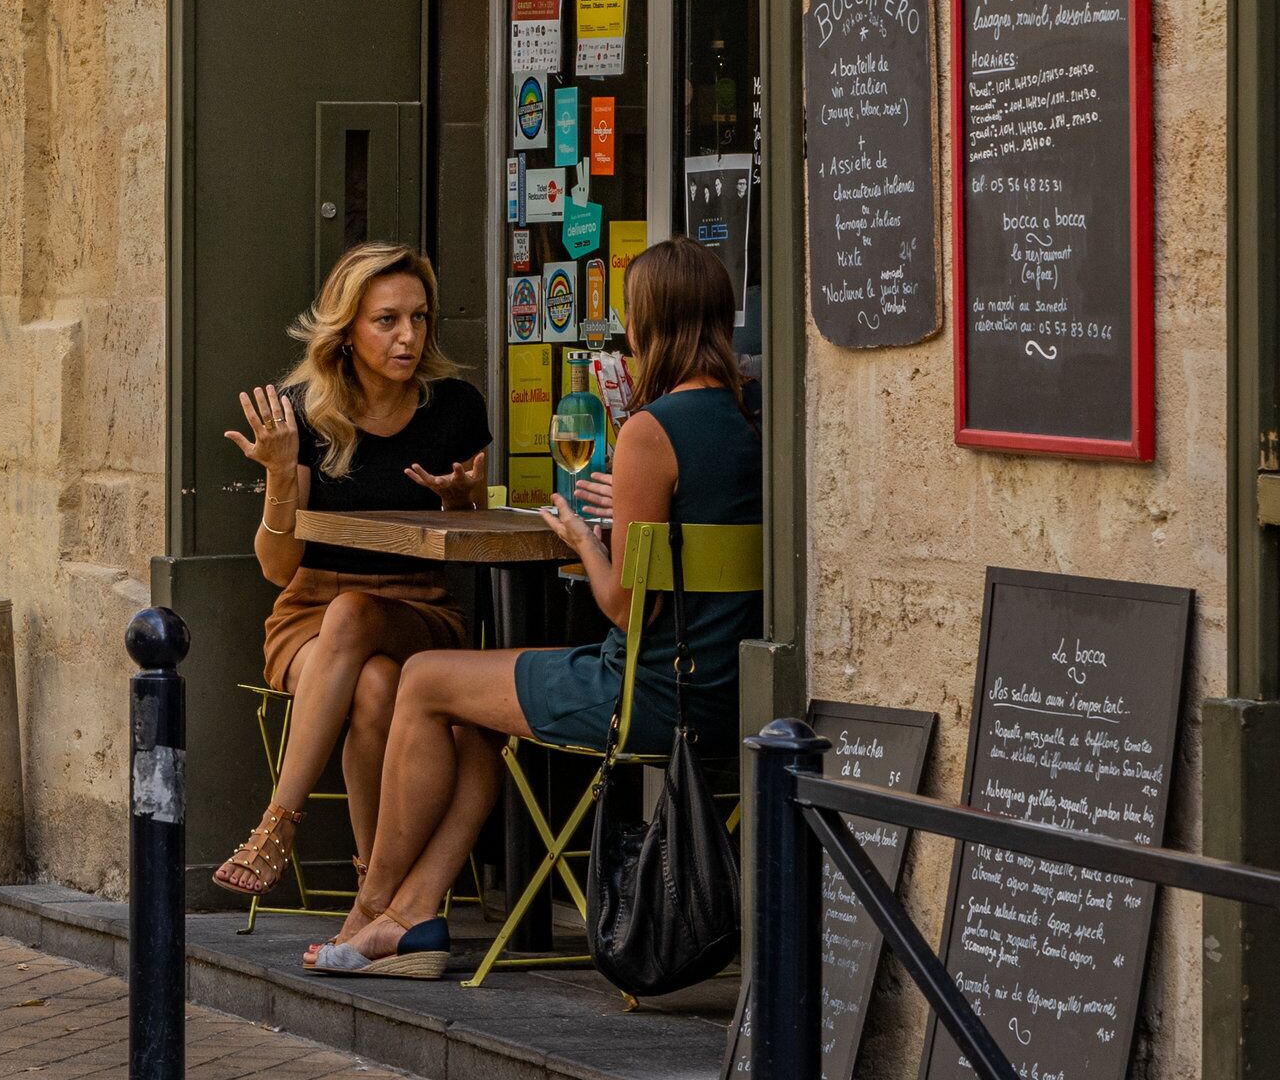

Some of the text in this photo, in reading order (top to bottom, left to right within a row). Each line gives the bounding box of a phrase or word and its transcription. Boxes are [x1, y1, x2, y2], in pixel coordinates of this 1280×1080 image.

[1055, 2, 1091, 26] desserts
[840, 52, 889, 77] bouteille de
[831, 77, 888, 99] vin italien
[830, 150, 888, 175] Assiette de
[536, 184, 547, 192] Ticket
[833, 182, 881, 201] charcuteries
[990, 178, 1063, 193] 05 56 48 25 31
[862, 205, 870, 215] ou
[1003, 213, 1039, 231] bocca
[1055, 207, 1087, 230] bocca
[567, 222, 597, 237] deliveroo
[835, 209, 901, 240] fromages italiens
[863, 236, 872, 246] ou
[1011, 243, 1021, 261] le
[837, 247, 862, 266] Mixte
[866, 278, 875, 298] le
[880, 280, 899, 305] jeudi
[973, 295, 1068, 312] du mardi au samedi
[975, 314, 1112, 340] réservation 05 57 83 69 66
[1052, 637, 1107, 667] La bocca
[990, 676, 1068, 708] Nos salades aussi
[836, 730, 884, 760] Sandwiches
[1070, 734, 1153, 754] de tomates
[841, 760, 901, 787] de la 5€
[1084, 760, 1093, 773] de
[1095, 760, 1120, 781] jambon
[1123, 759, 1135, 777] San
[985, 778, 1025, 808] Aubergines
[1092, 802, 1121, 825] jambon
[1123, 804, 1141, 823] blanc
[977, 844, 1014, 864] Mix de la
[1006, 877, 1113, 911] oignon tomate
[967, 896, 1017, 923] Grande salade
[962, 919, 1068, 962] jambon tomate
[995, 982, 1057, 1015] mix de légumes
[1020, 1062, 1039, 1080] de la
